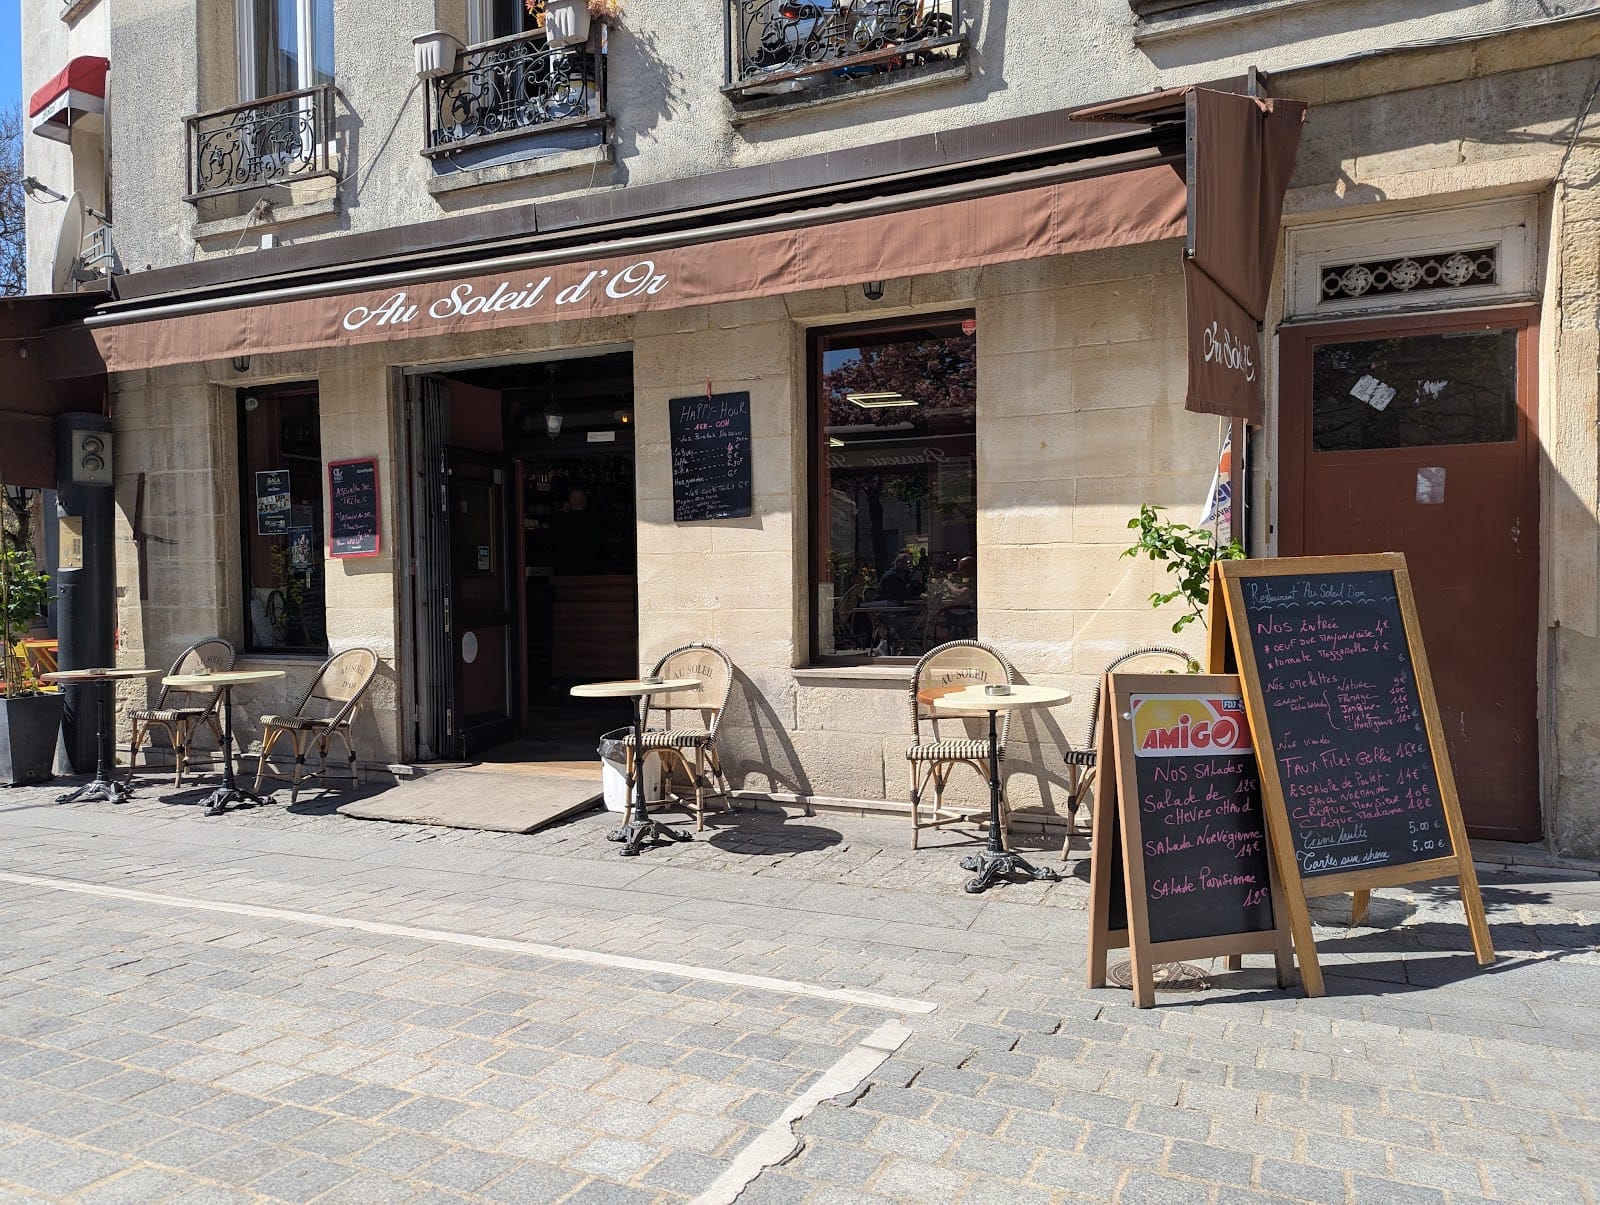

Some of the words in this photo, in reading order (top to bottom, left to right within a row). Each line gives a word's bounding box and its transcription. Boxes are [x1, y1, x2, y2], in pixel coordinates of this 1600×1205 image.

[343, 293, 420, 330] Au
[430, 276, 551, 319] Soleil
[555, 260, 669, 306] d'Or
[673, 668, 685, 679] AU
[687, 664, 713, 680] SOLEIL
[941, 673, 954, 687] AU
[956, 667, 989, 684] SOLEIL
[1224, 701, 1237, 709] FDJ
[1206, 784, 1227, 801] de
[1296, 850, 1338, 871] Tartes
